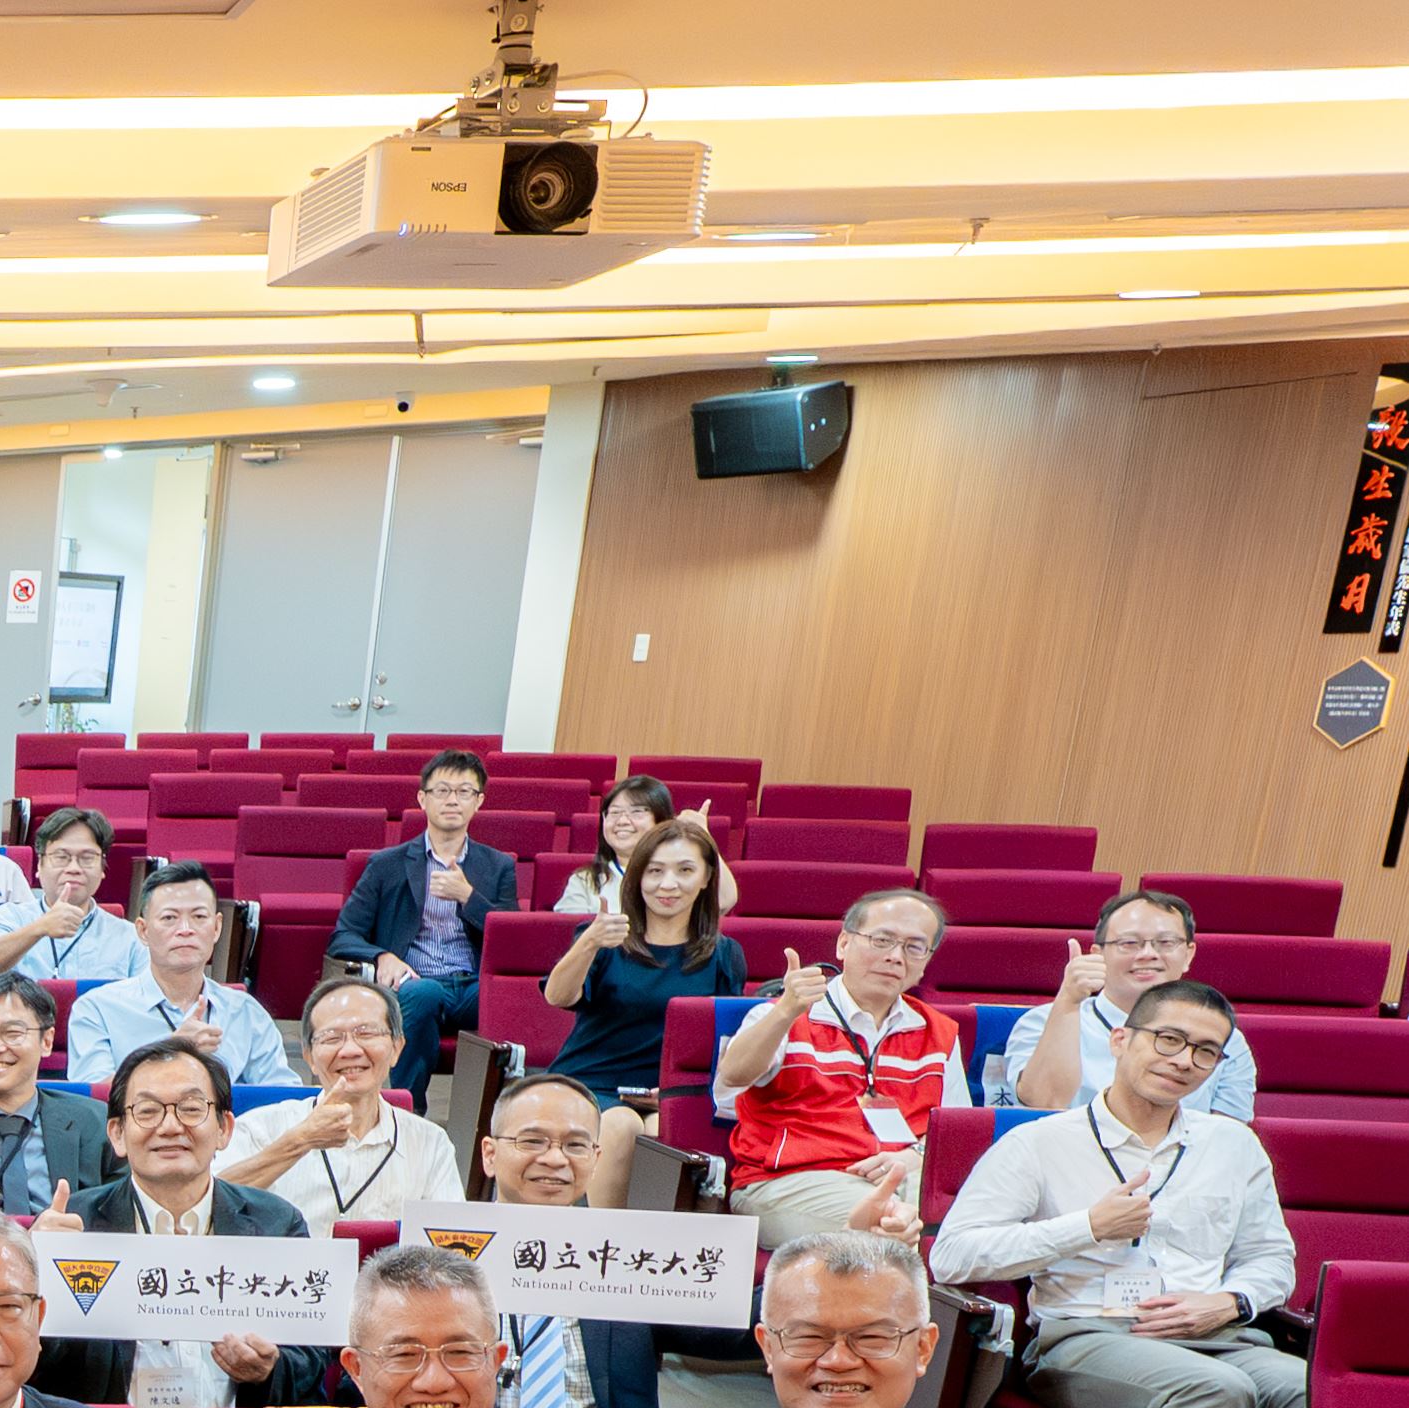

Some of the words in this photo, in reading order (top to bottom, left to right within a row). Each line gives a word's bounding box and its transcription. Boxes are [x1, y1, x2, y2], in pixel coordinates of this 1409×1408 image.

[431, 181, 467, 192] EPSON
[513, 1239, 725, 1283] 國立中央大學
[137, 1265, 332, 1305] 國立中央大學
[511, 1277, 573, 1291] National
[579, 1280, 633, 1295] Central
[639, 1284, 717, 1301] University
[136, 1303, 195, 1316] National
[199, 1305, 250, 1318] Central
[255, 1307, 327, 1321] University
